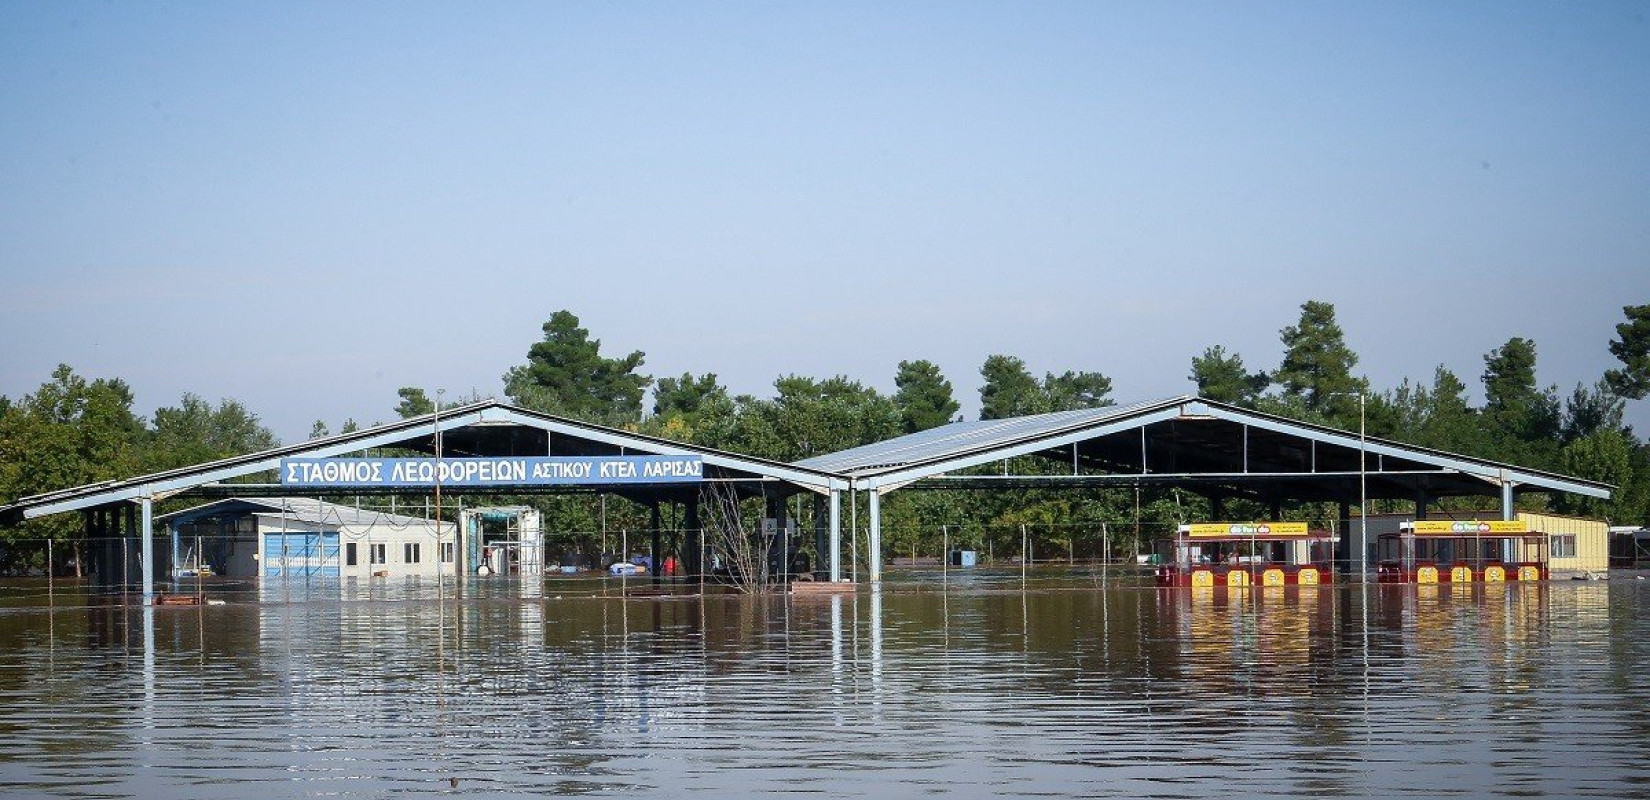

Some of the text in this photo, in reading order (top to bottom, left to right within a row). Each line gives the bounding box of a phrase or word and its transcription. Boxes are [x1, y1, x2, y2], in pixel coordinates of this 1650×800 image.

[287, 460, 702, 482] ΣΤΑΘΜΟΣ ΛΕΩΦΟΡΕΙΩΝ ΑΣΤΙΚΟΥ ΚΤΕΛ ΛΑΡΙΣΑΣ
